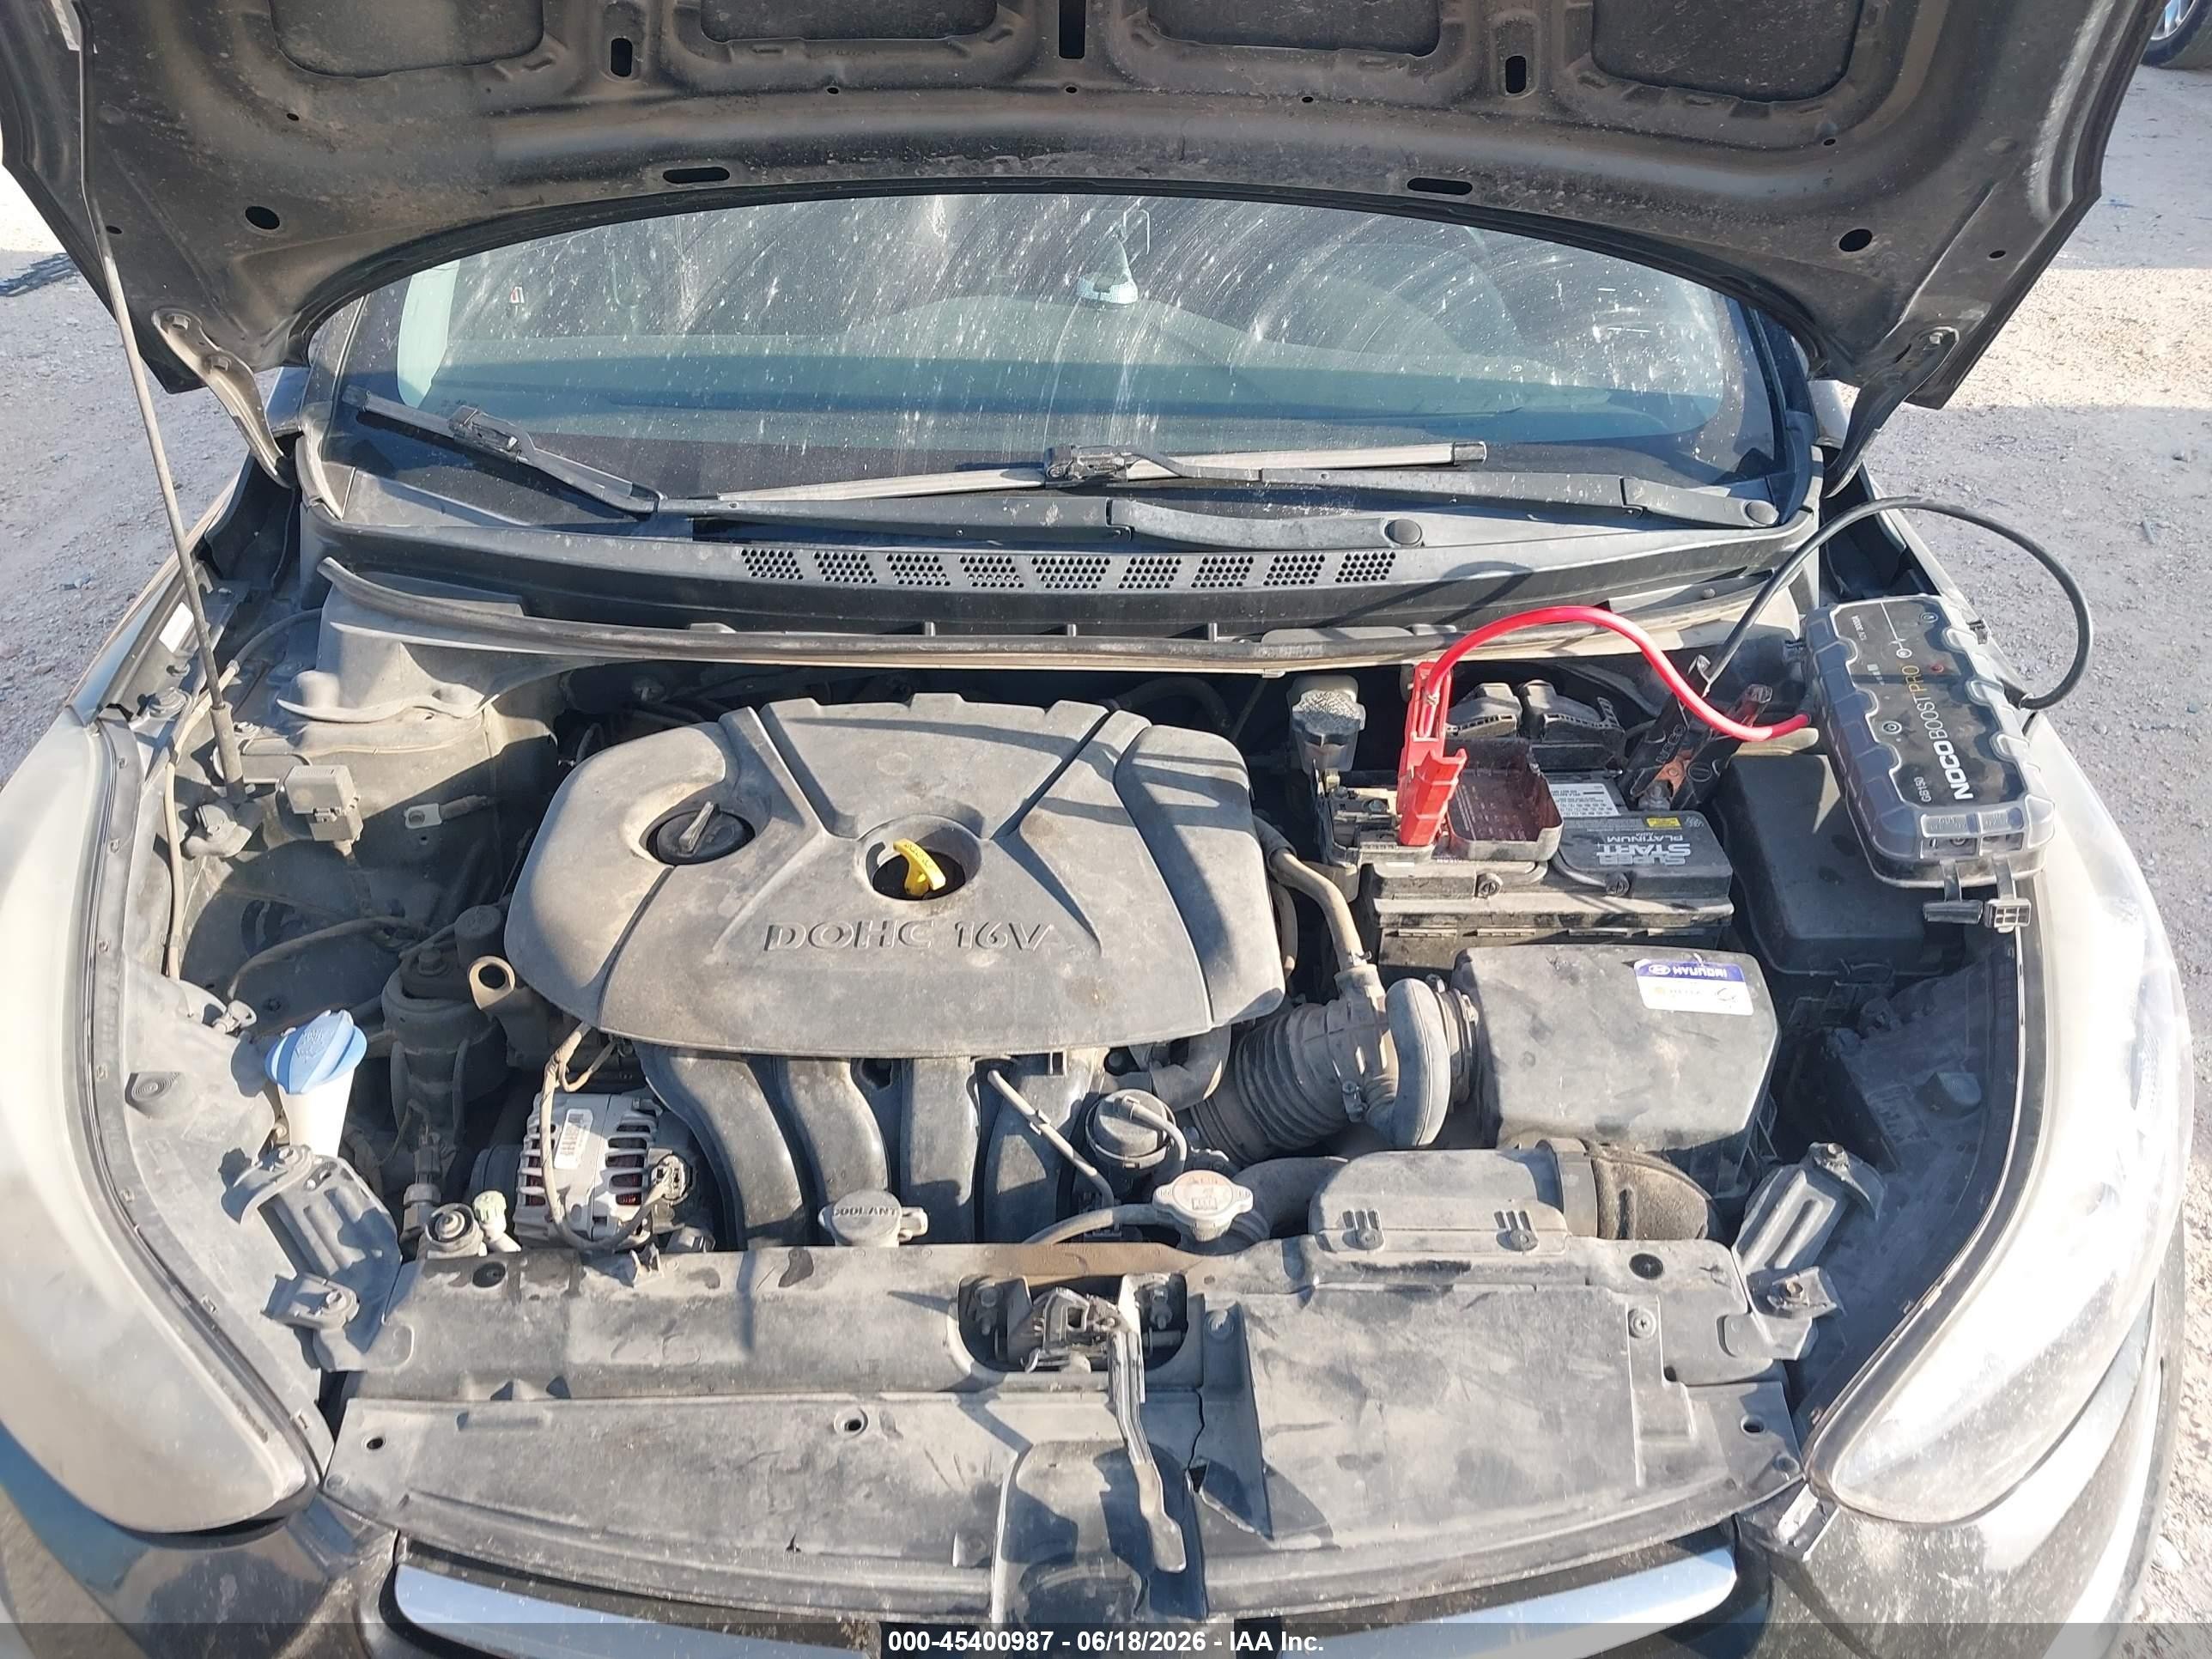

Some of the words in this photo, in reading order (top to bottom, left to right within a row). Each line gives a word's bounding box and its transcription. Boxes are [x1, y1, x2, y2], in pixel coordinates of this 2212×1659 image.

[1902, 665, 1929, 696] PRO
[1911, 693, 1948, 740] BOOST
[1934, 740, 1974, 800] NOCO
[1913, 775, 1932, 803] GB150
[1607, 834, 1684, 843] PLATINUM
[1595, 843, 1692, 857] START
[1599, 854, 1686, 866] SUPER
[763, 920, 935, 952] DOHC
[954, 921, 1054, 952] 16V
[1672, 965, 1728, 978] HYUNDAI
[831, 1206, 898, 1217] COOLANT
